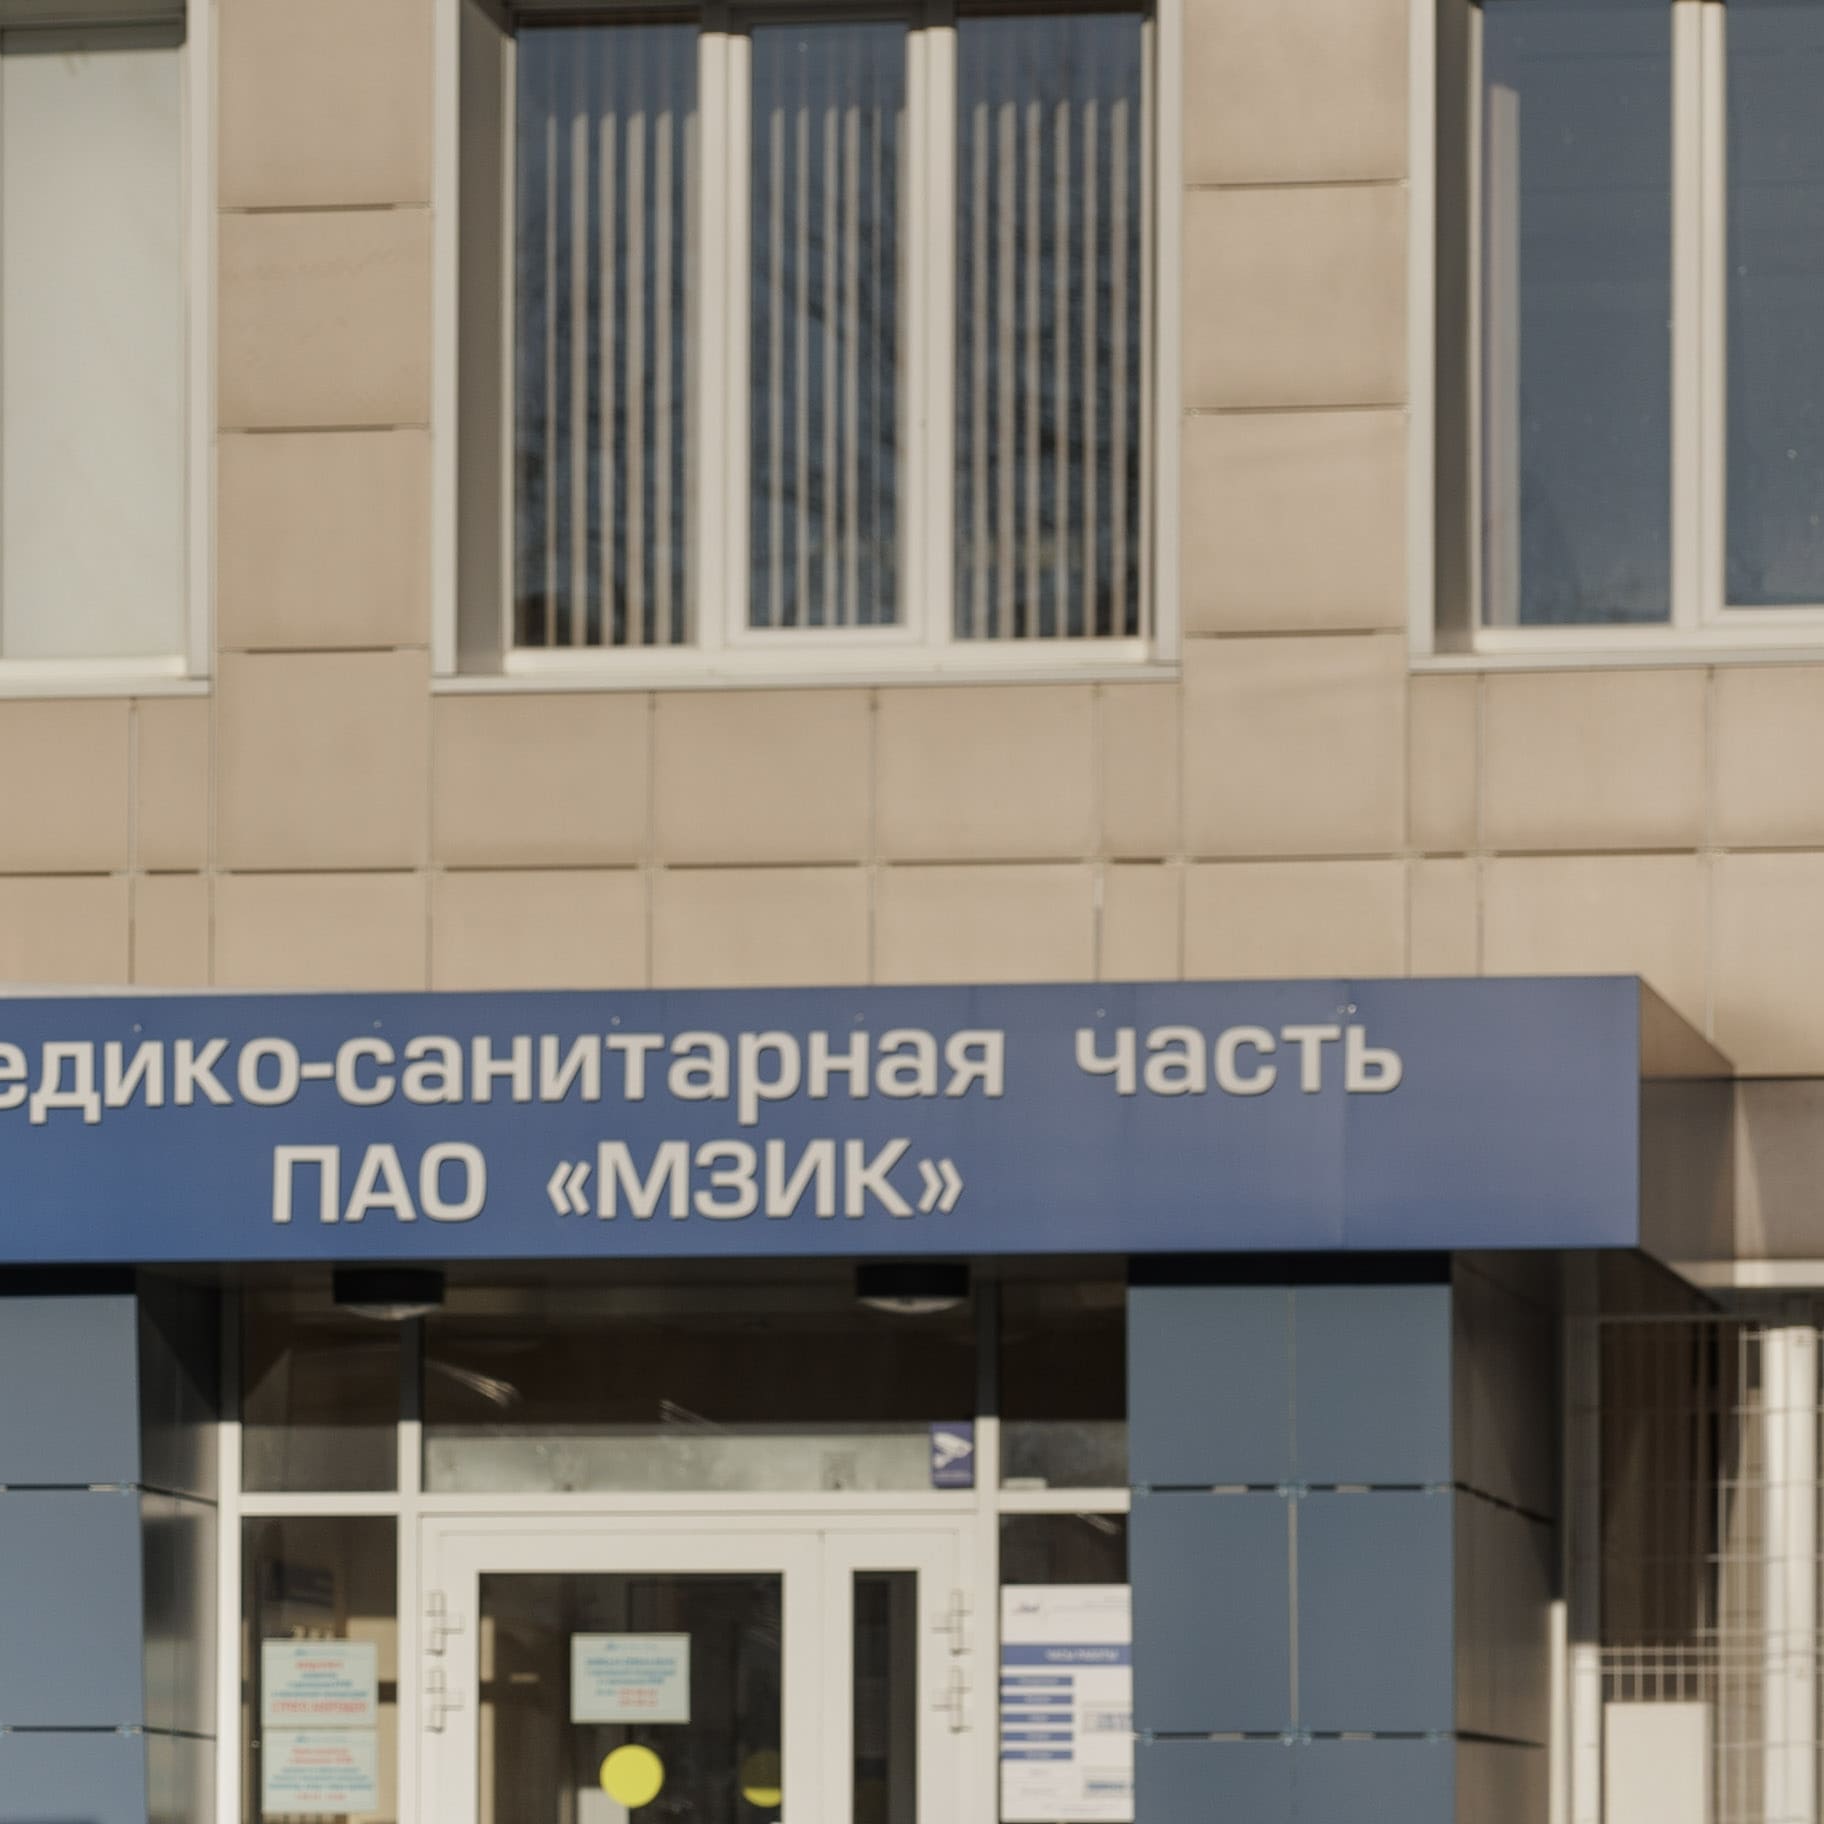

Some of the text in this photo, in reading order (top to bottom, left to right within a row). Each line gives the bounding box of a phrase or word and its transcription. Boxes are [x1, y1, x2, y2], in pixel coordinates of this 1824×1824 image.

[1075, 1024, 1405, 1096] часть
[272, 1139, 964, 1223] ПАО «МЗИК»
